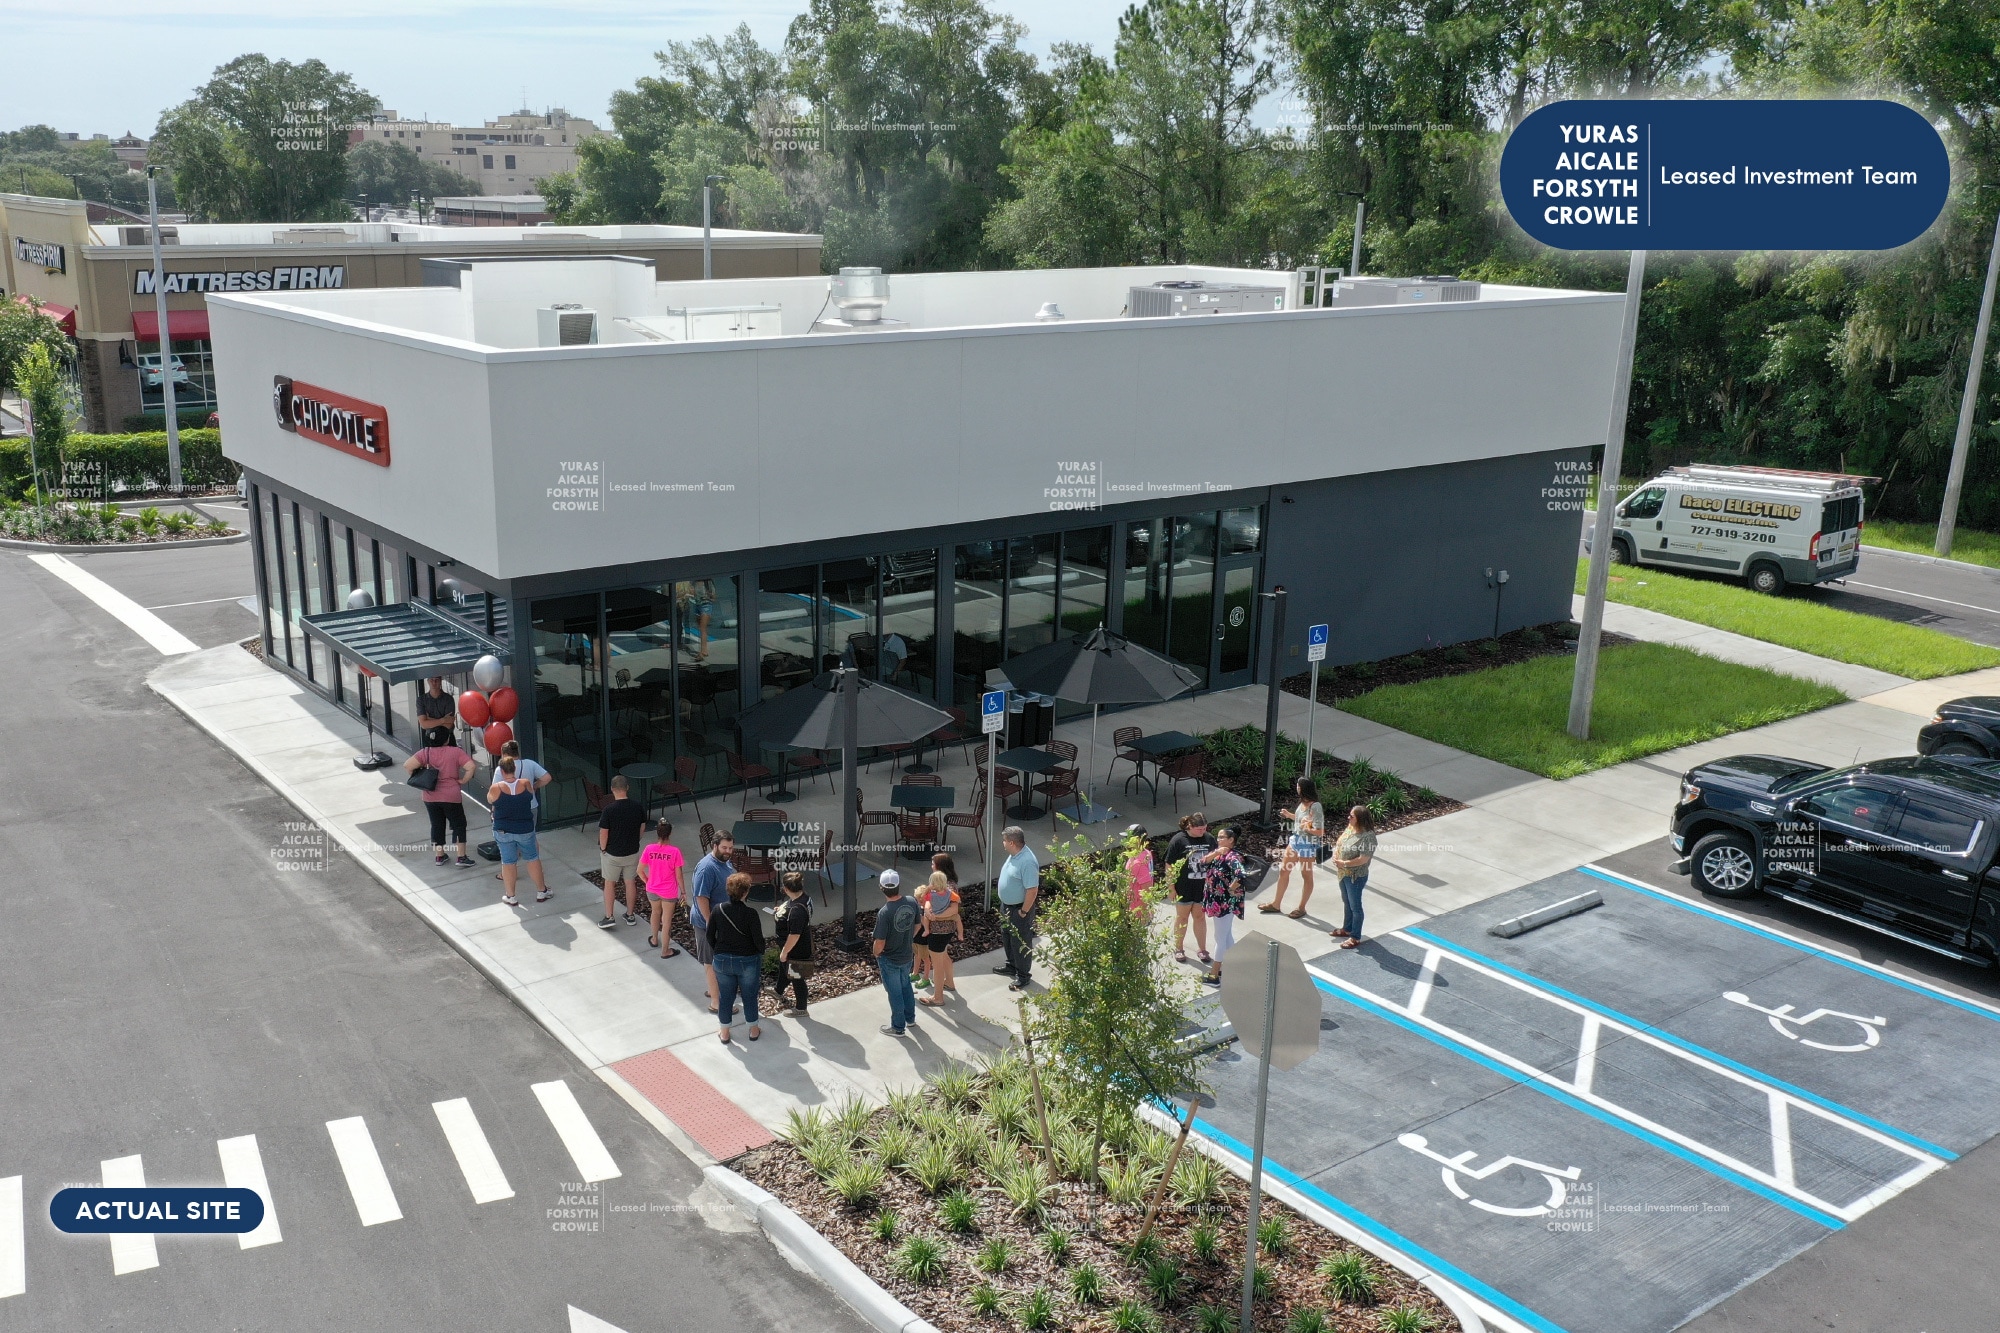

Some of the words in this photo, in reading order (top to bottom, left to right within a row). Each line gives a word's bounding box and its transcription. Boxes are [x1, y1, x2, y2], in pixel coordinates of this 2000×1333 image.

[291, 395, 377, 453] CHIPOTLE
[1680, 494, 1723, 512] Raco
[1724, 498, 1802, 521] ELECTRIC
[1691, 525, 1776, 544] 727-919-3200
[452, 589, 466, 607] 911
[649, 852, 671, 861] STAFF
